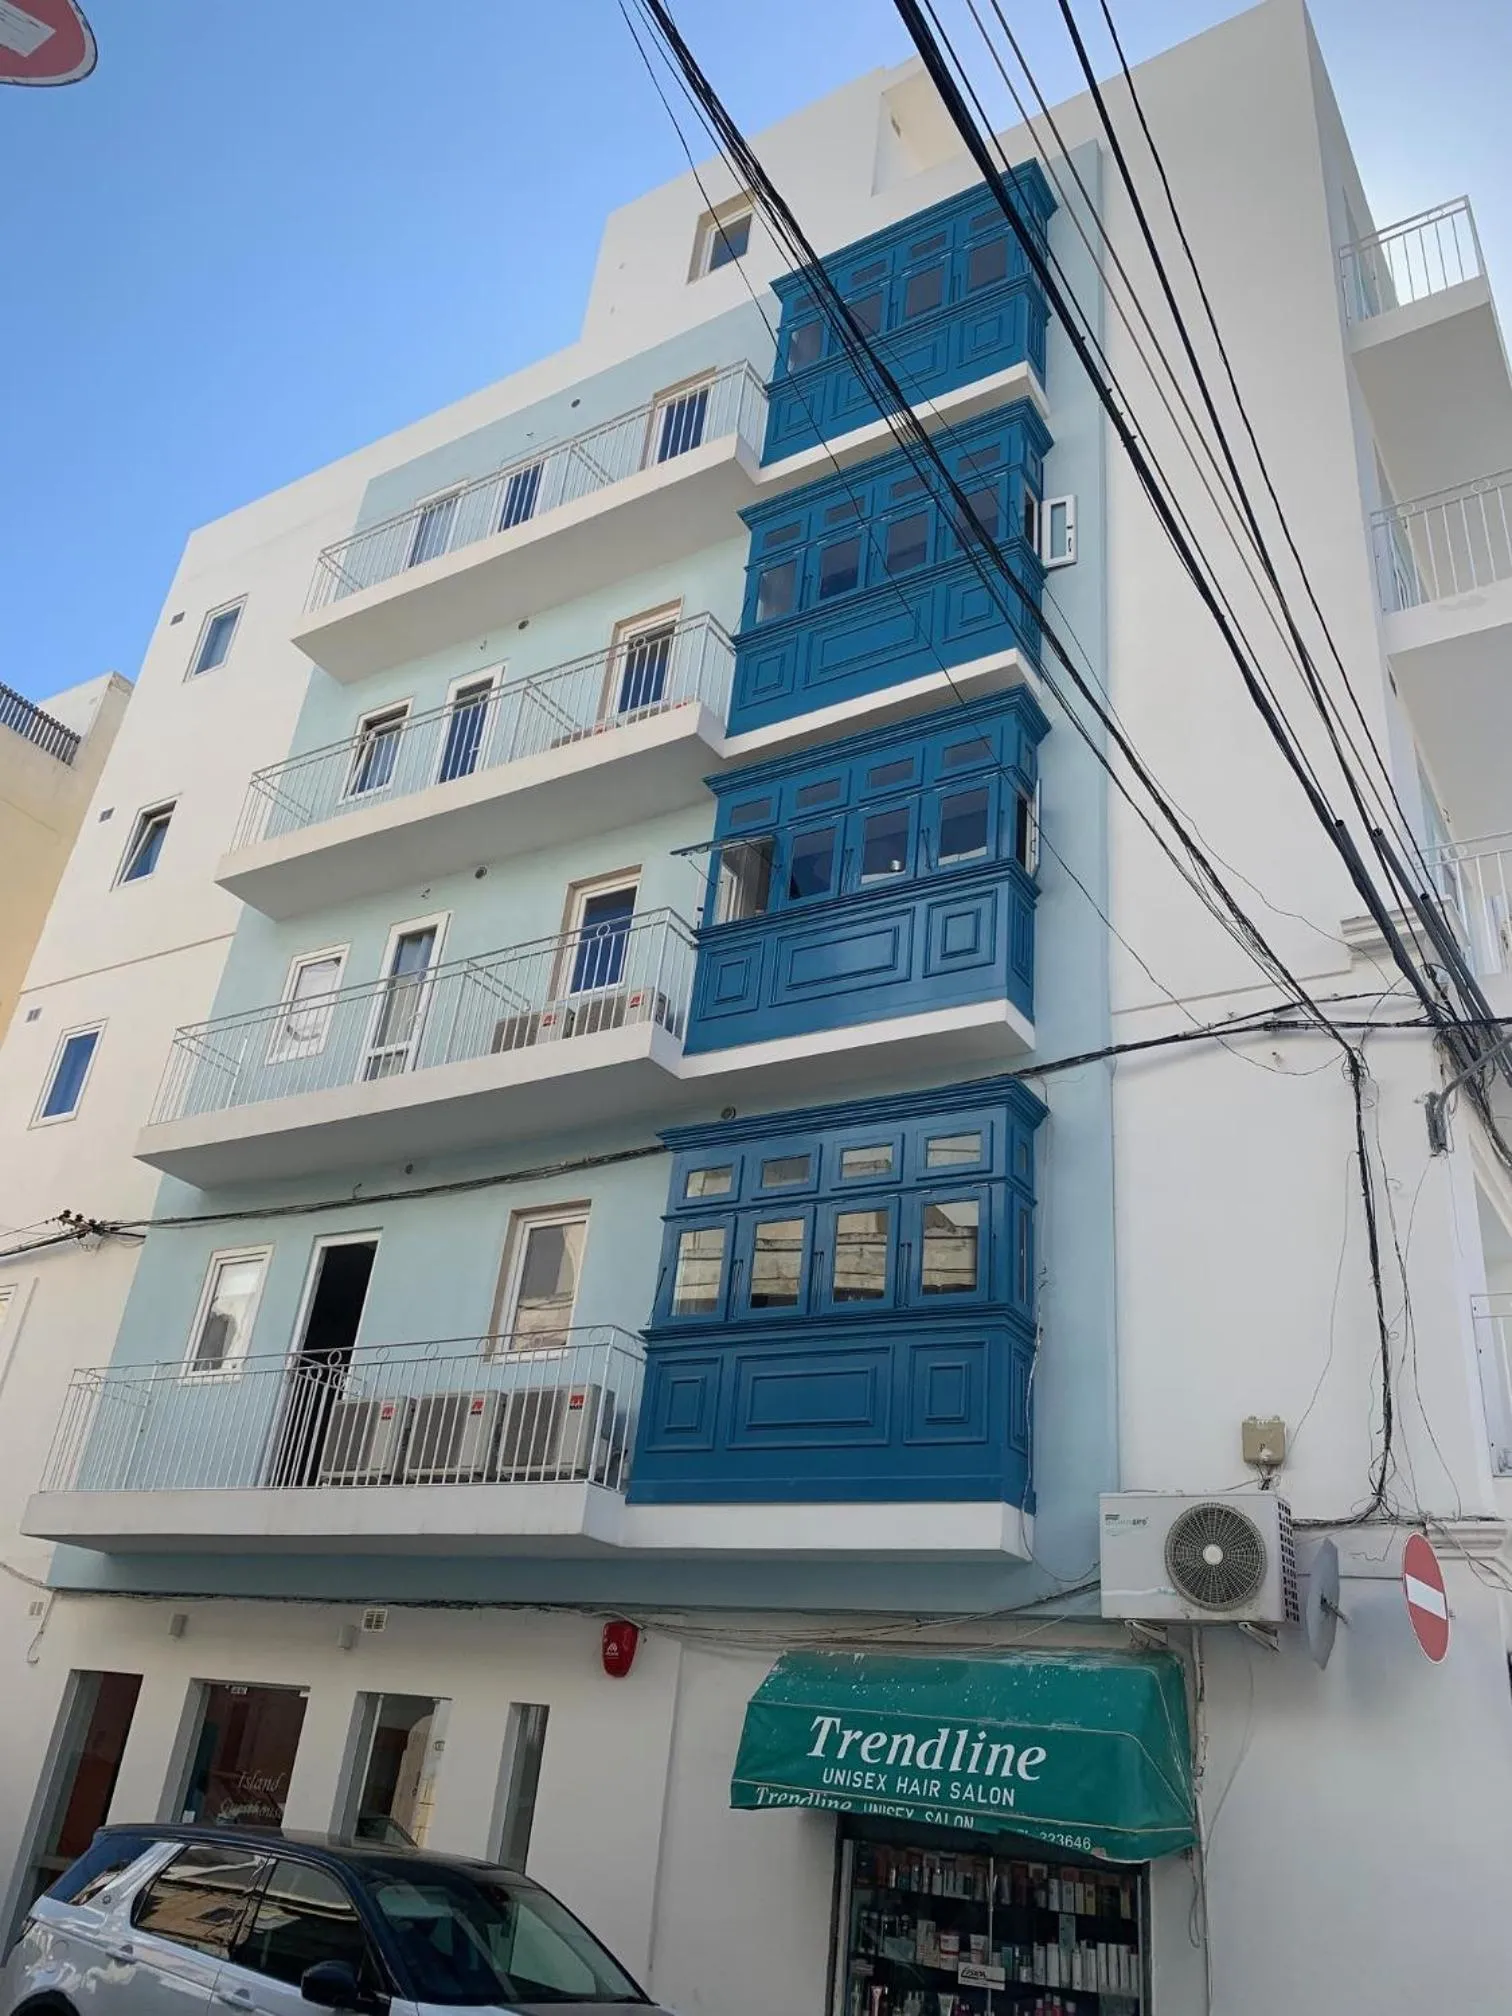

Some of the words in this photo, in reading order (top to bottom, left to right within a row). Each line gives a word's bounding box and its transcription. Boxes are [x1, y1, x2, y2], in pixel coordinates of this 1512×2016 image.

[806, 1715, 1047, 1781] Trendline
[822, 1767, 887, 1792] UNISEX
[896, 1777, 941, 1798] HAIR
[950, 1782, 1015, 1807] SALON
